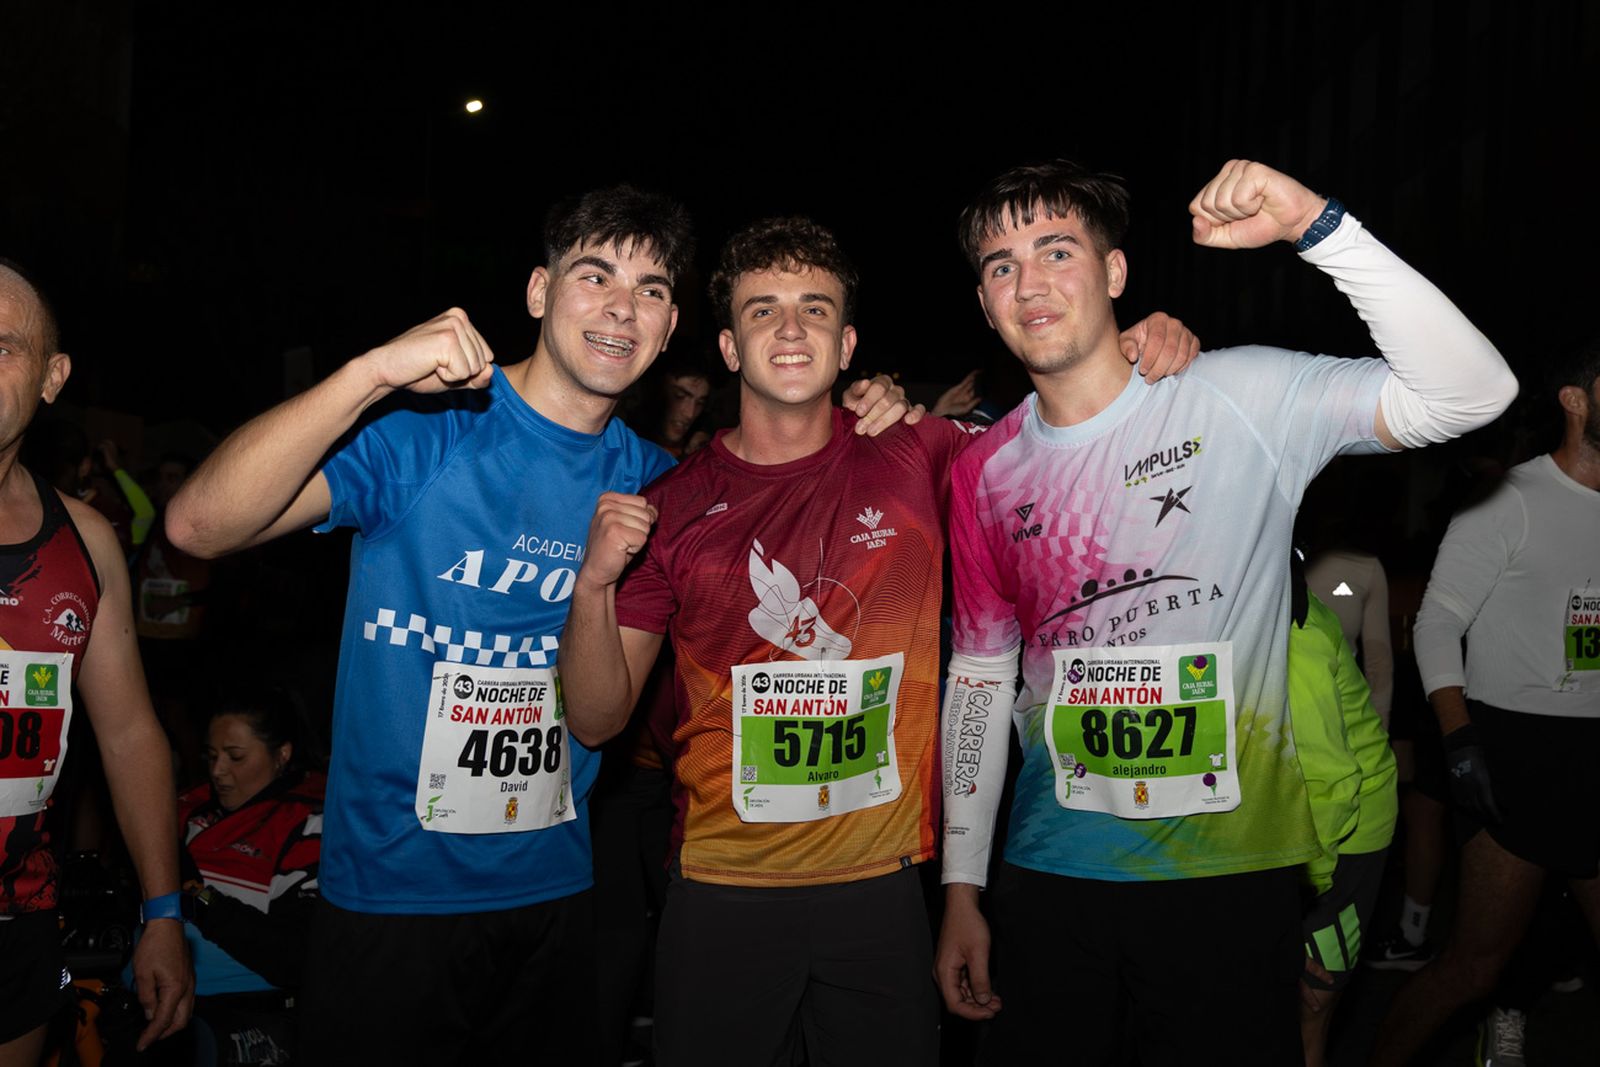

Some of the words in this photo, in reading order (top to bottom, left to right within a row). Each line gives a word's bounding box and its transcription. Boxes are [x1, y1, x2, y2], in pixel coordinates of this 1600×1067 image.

[850, 533, 870, 544] CAJA
[871, 528, 898, 540] RURAL
[1011, 523, 1043, 543] vive
[1109, 583, 1224, 632] PUERTA
[1571, 614, 1592, 625] SAN
[785, 614, 816, 648] 43
[752, 677, 770, 688] 43
[1087, 666, 1136, 682] NOCHE
[1140, 666, 1161, 682] DE
[456, 680, 473, 694] 43
[475, 687, 526, 704] NOCHE
[527, 687, 547, 702] DE
[774, 680, 824, 694] NOCHE
[828, 680, 847, 694] DE
[1068, 687, 1098, 704] SAN
[1101, 683, 1163, 705] ANTÓN
[450, 704, 489, 725] SAN
[490, 702, 543, 725] ANTÓN
[753, 699, 786, 716] SAN
[790, 695, 848, 716] ANTÓN
[774, 715, 866, 767] 5715
[1081, 706, 1197, 760] 8627
[457, 725, 562, 778] 4638
[954, 690, 992, 796] CARRERA
[808, 770, 839, 782] Alvaro
[1113, 764, 1167, 778] alejandro
[500, 780, 528, 793] David
